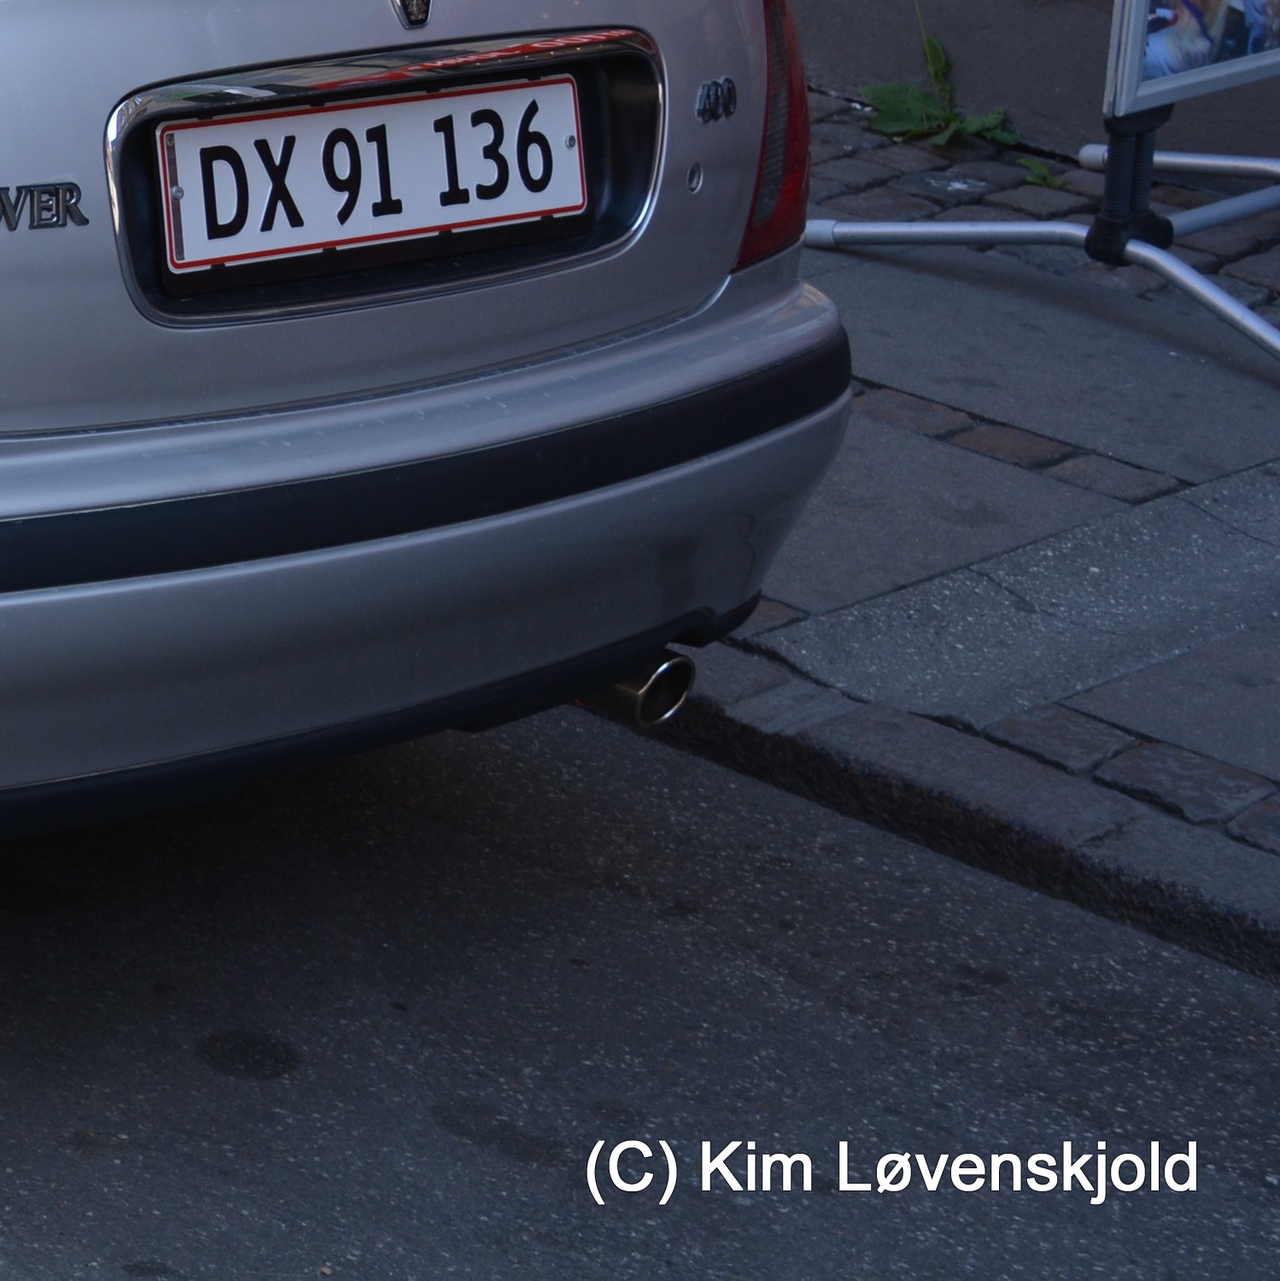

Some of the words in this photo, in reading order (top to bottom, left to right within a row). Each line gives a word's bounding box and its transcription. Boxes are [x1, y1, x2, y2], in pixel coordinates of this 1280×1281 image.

[197, 134, 304, 241] DX
[320, 125, 404, 227] 91
[432, 99, 555, 208] 136
